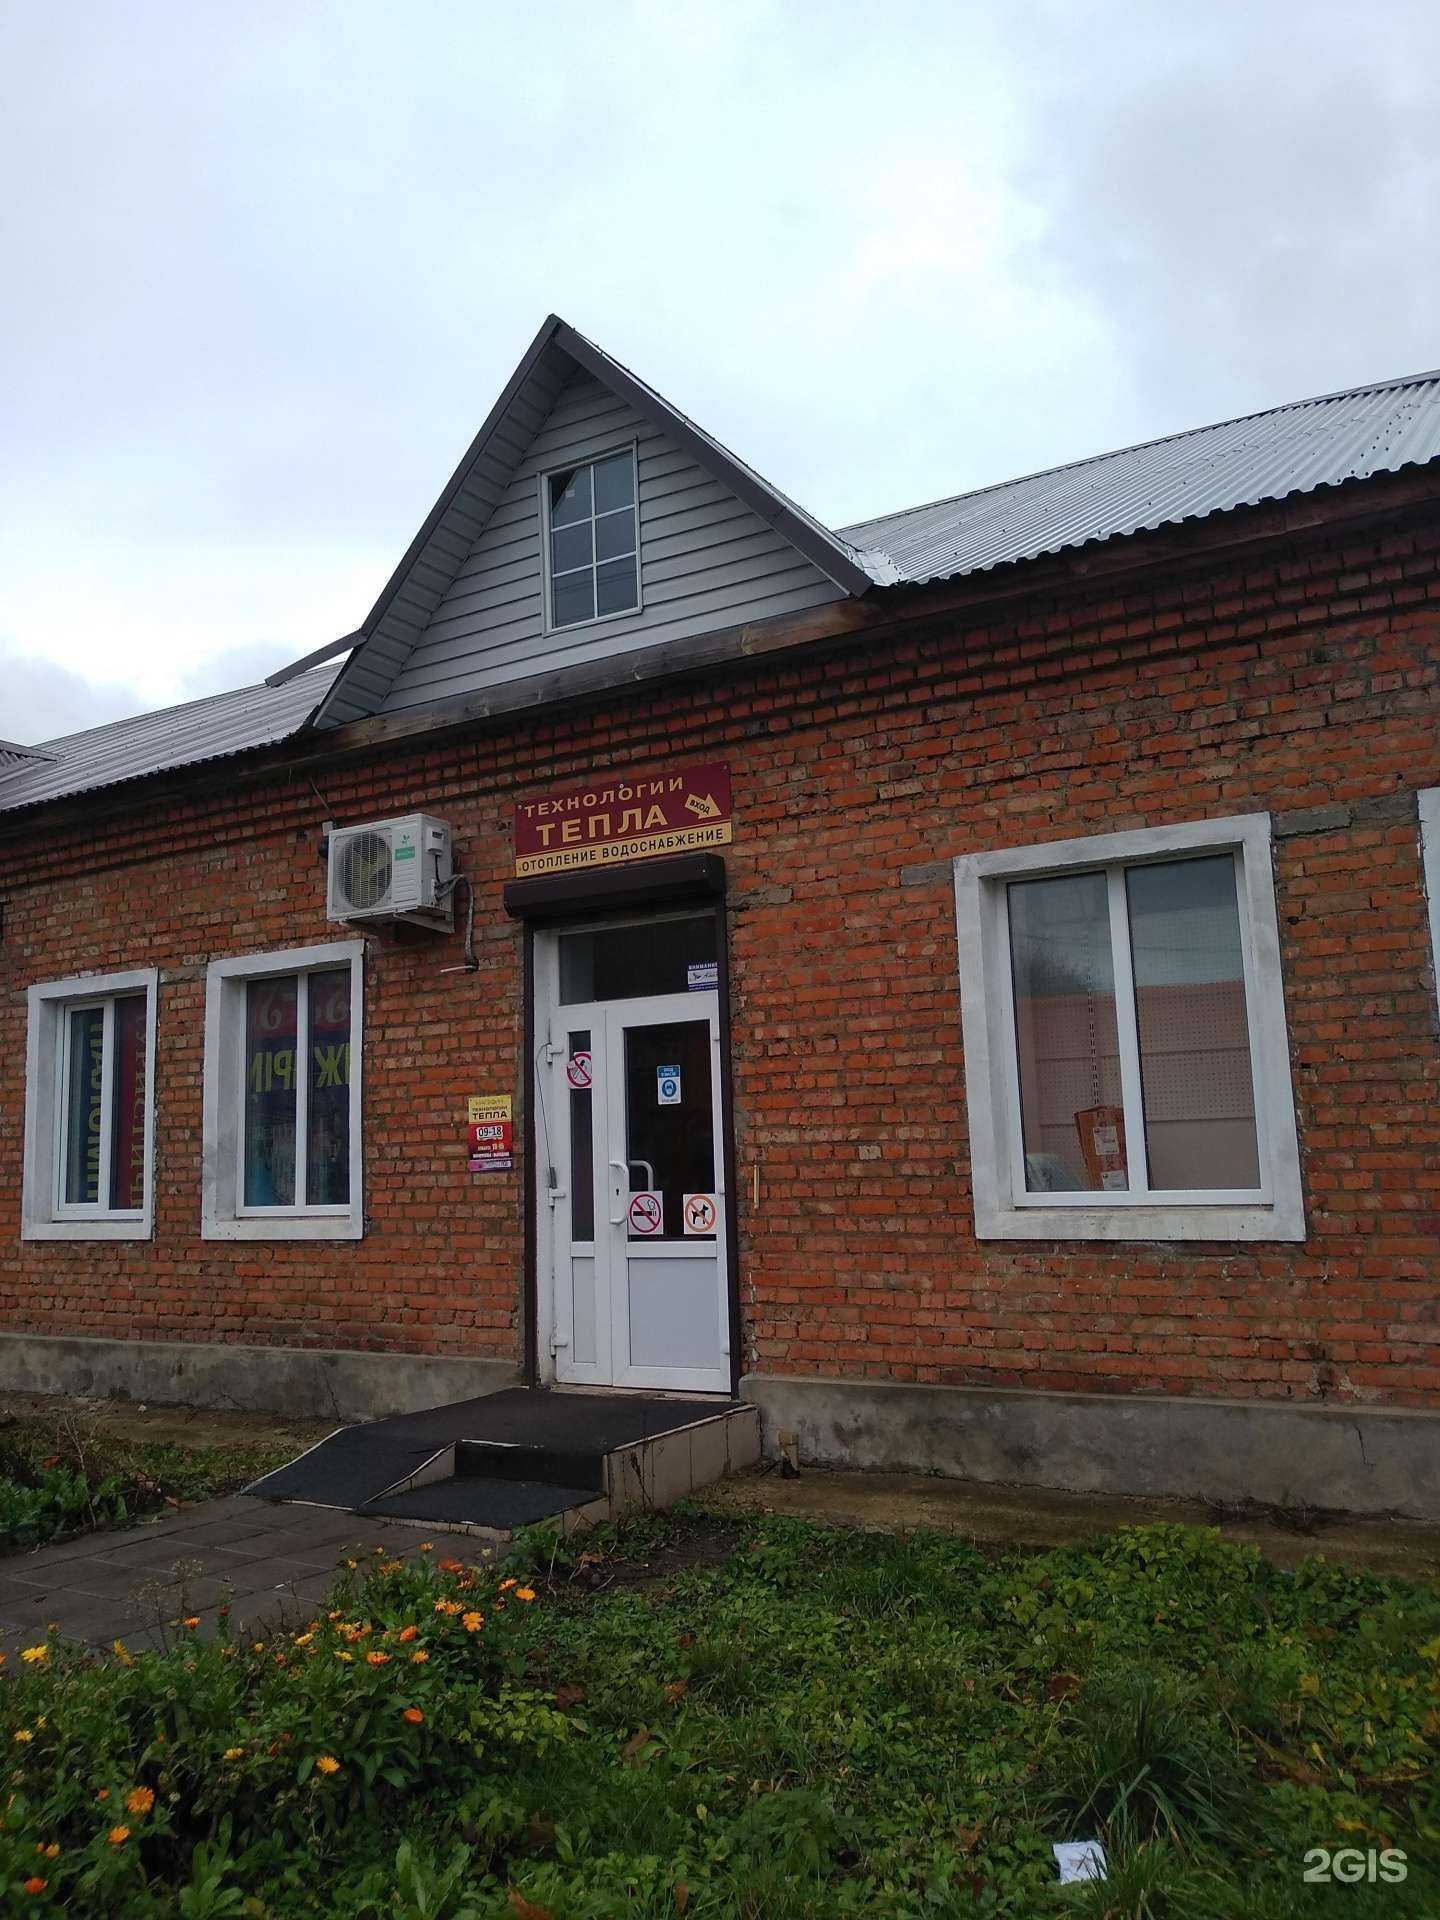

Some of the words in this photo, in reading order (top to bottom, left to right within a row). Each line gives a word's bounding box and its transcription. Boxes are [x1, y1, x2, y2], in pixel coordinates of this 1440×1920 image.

[524, 776, 684, 818] ТЕХНОЛОГИИ
[536, 804, 669, 846] ТЕПЛА
[522, 851, 597, 872] ОТОПЛЕНИЕ
[602, 828, 724, 856] ВОДОСНАБЖЕНИЕ
[472, 1111, 508, 1120] ТЕПЛА
[478, 1126, 501, 1137] 09-18
